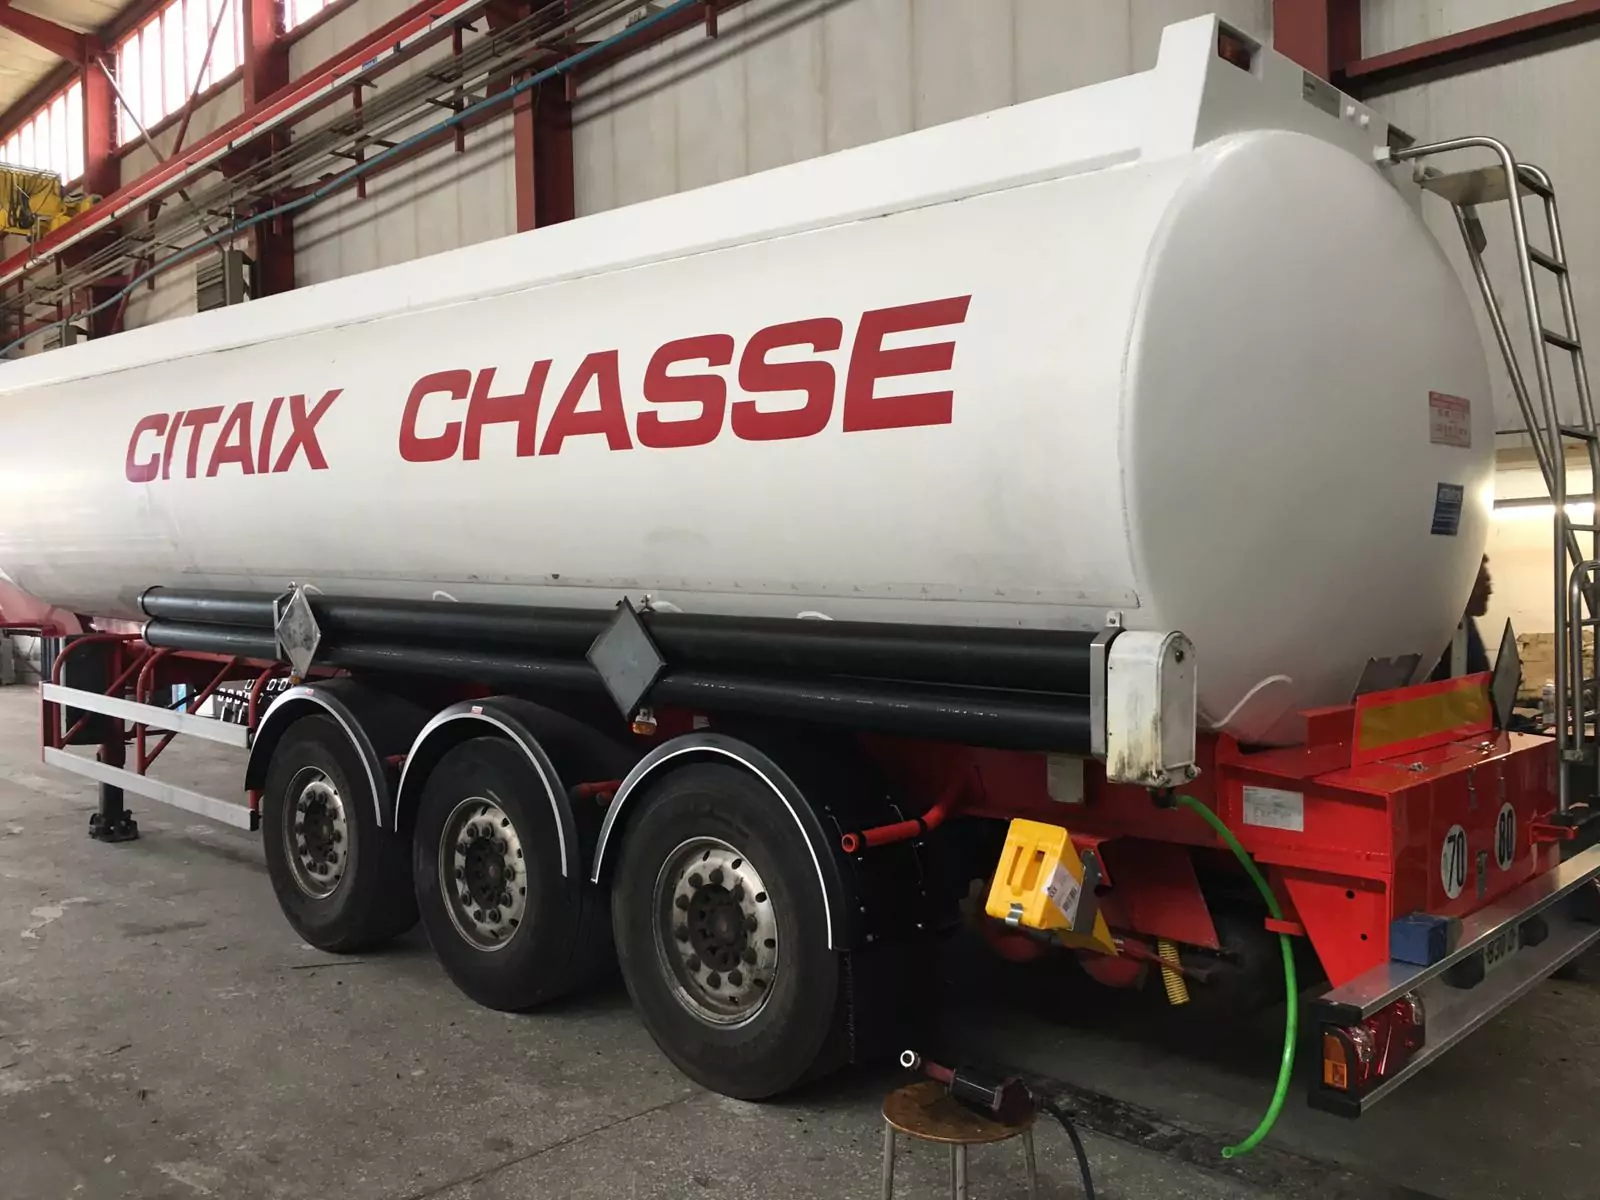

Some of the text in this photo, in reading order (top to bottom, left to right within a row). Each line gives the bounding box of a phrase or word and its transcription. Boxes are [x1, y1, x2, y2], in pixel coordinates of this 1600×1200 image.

[126, 295, 972, 482] CITAIX CHASSE
[1447, 830, 1464, 893] 70
[1499, 809, 1513, 865] 80
